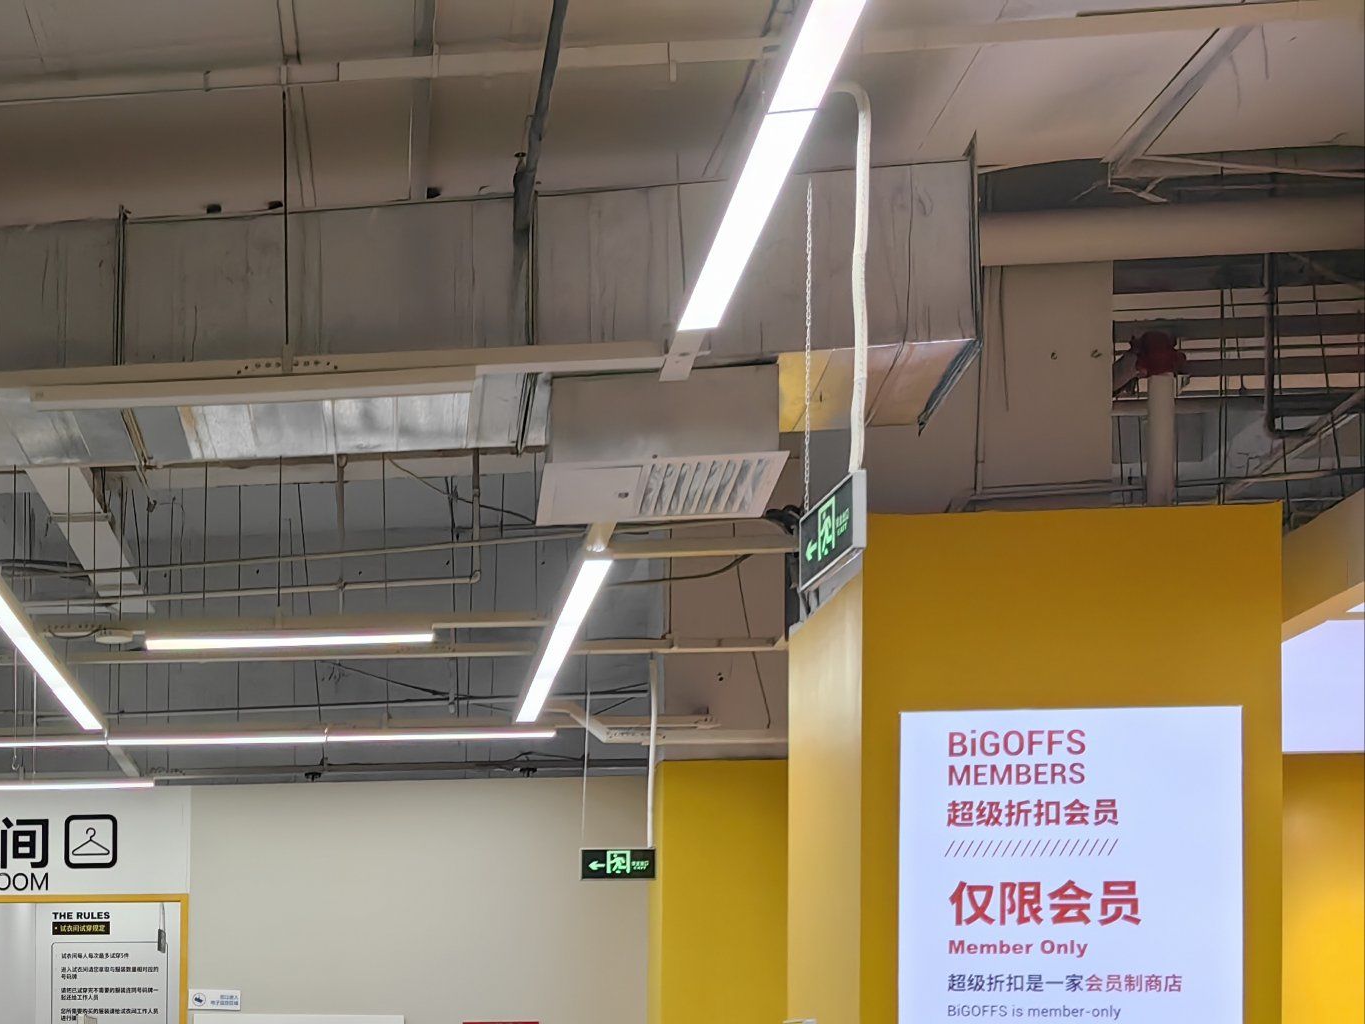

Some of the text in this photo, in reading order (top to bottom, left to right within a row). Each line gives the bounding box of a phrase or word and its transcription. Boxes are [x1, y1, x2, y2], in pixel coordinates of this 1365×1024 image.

[947, 729, 1087, 758] BiGOFFS
[947, 762, 1086, 787] MEMBERS
[946, 799, 1119, 829] 超级折扣会员
[949, 880, 1143, 927] 仅限会员
[52, 911, 110, 920] THE RULES
[60, 924, 106, 932] 试衣间试穿规定
[948, 939, 1088, 959] Member Only
[947, 973, 1183, 994] 超级折扣是一家会员制商店
[947, 1003, 1121, 1020] BiGOFFS is member-only
